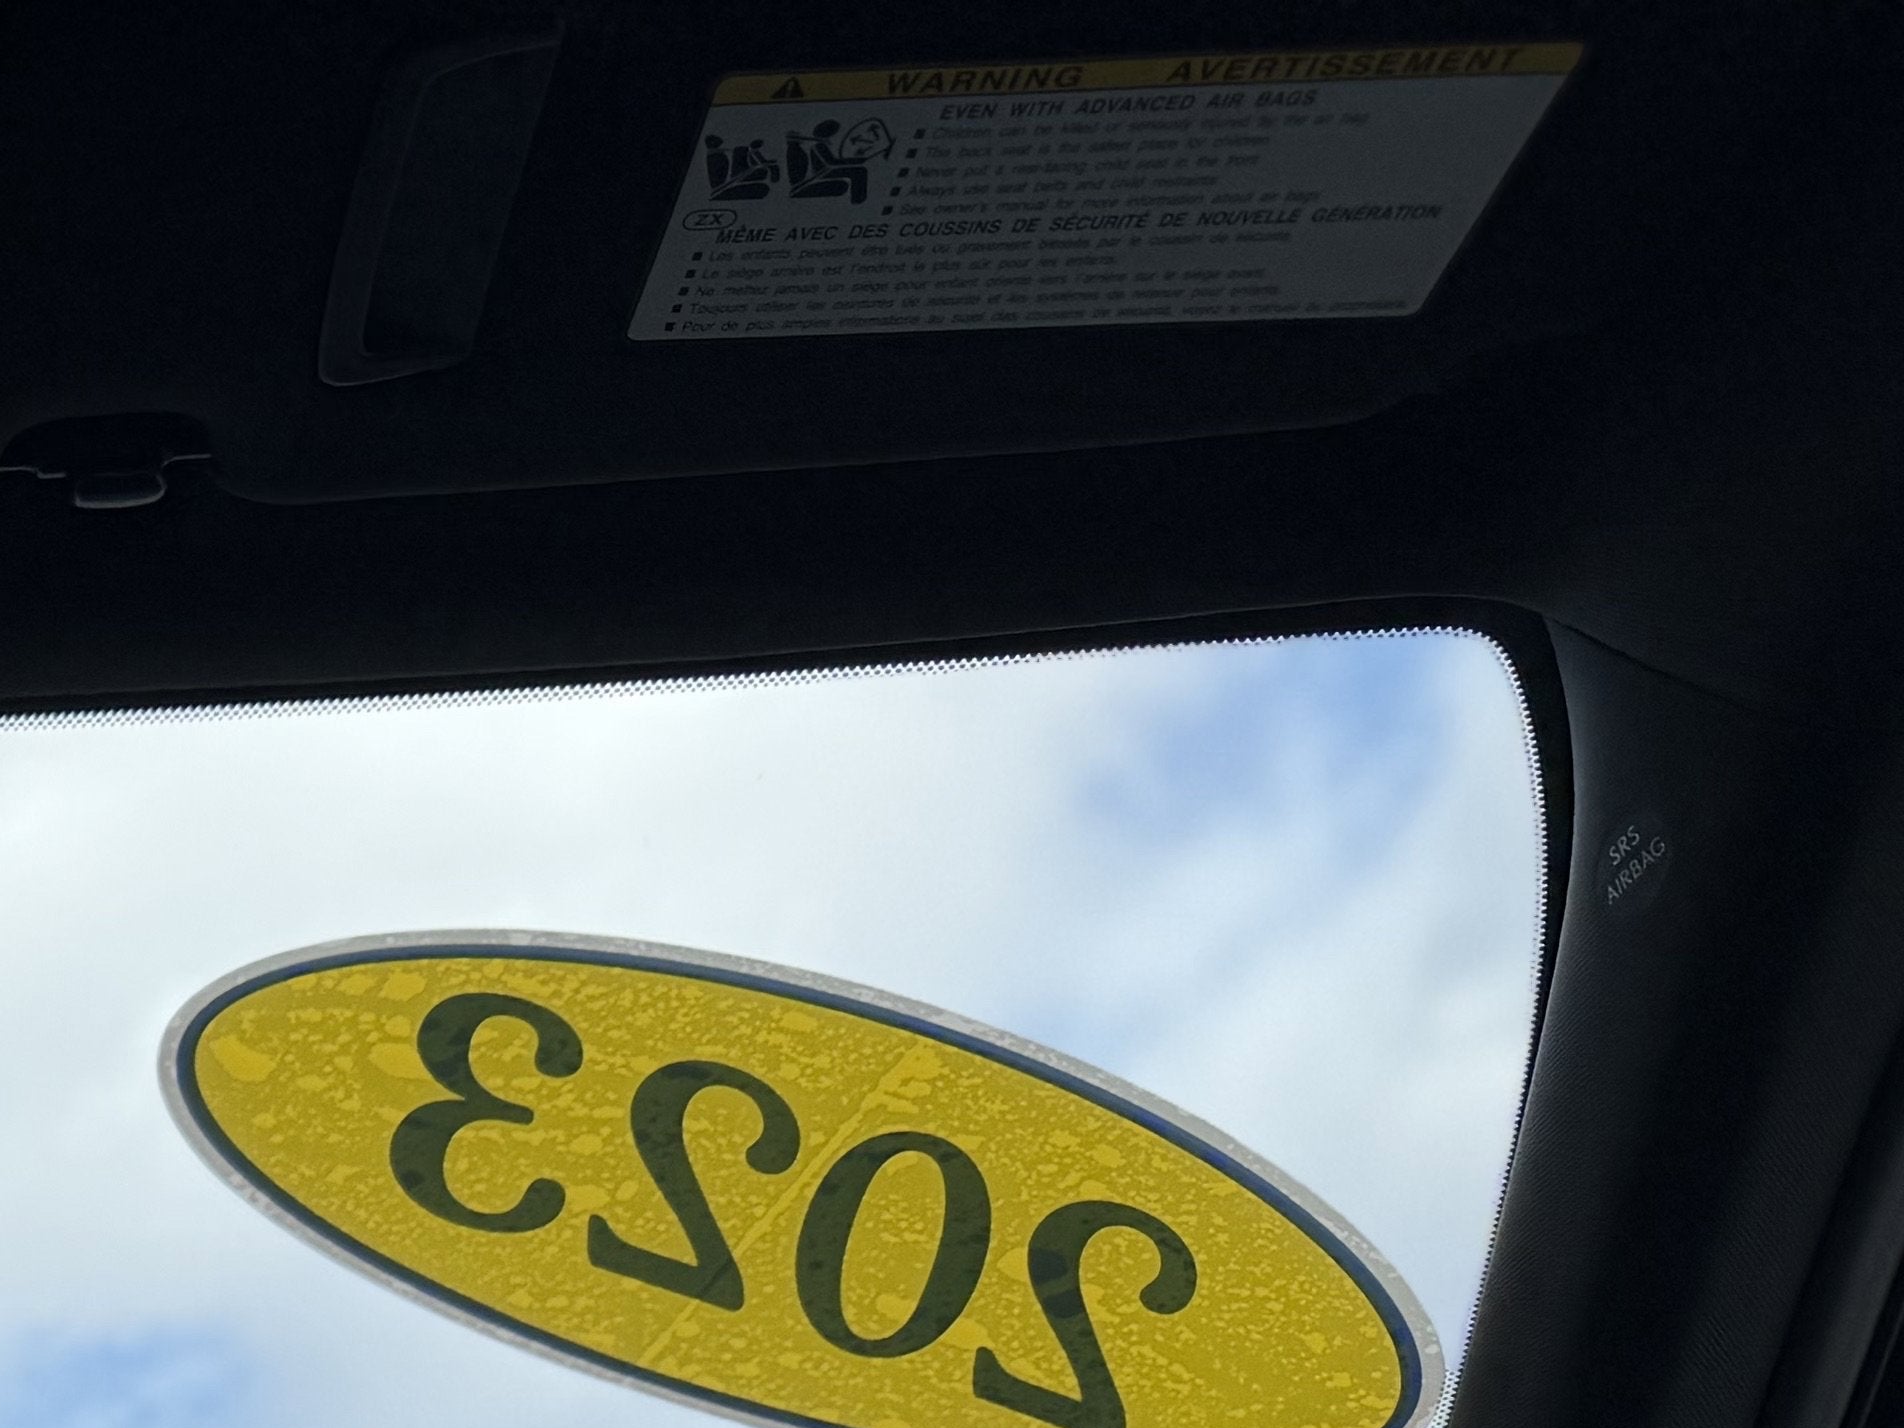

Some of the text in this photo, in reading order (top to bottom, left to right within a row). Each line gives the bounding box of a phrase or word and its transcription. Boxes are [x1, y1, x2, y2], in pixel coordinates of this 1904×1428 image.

[887, 47, 1523, 94] WARNING AVERTISSEMENT
[938, 89, 1320, 117] EVEN WITH ADVANCED AIR BAGS
[695, 214, 724, 227] ZX
[784, 224, 840, 239] AVEC
[847, 222, 892, 237] DES
[897, 218, 1004, 235] COUSSINS
[1010, 217, 1042, 231] DE
[1156, 212, 1189, 227] DE
[1194, 208, 1304, 225] NOUVELLE
[1609, 825, 1640, 866] SRS
[1607, 836, 1665, 905] AIRBAG
